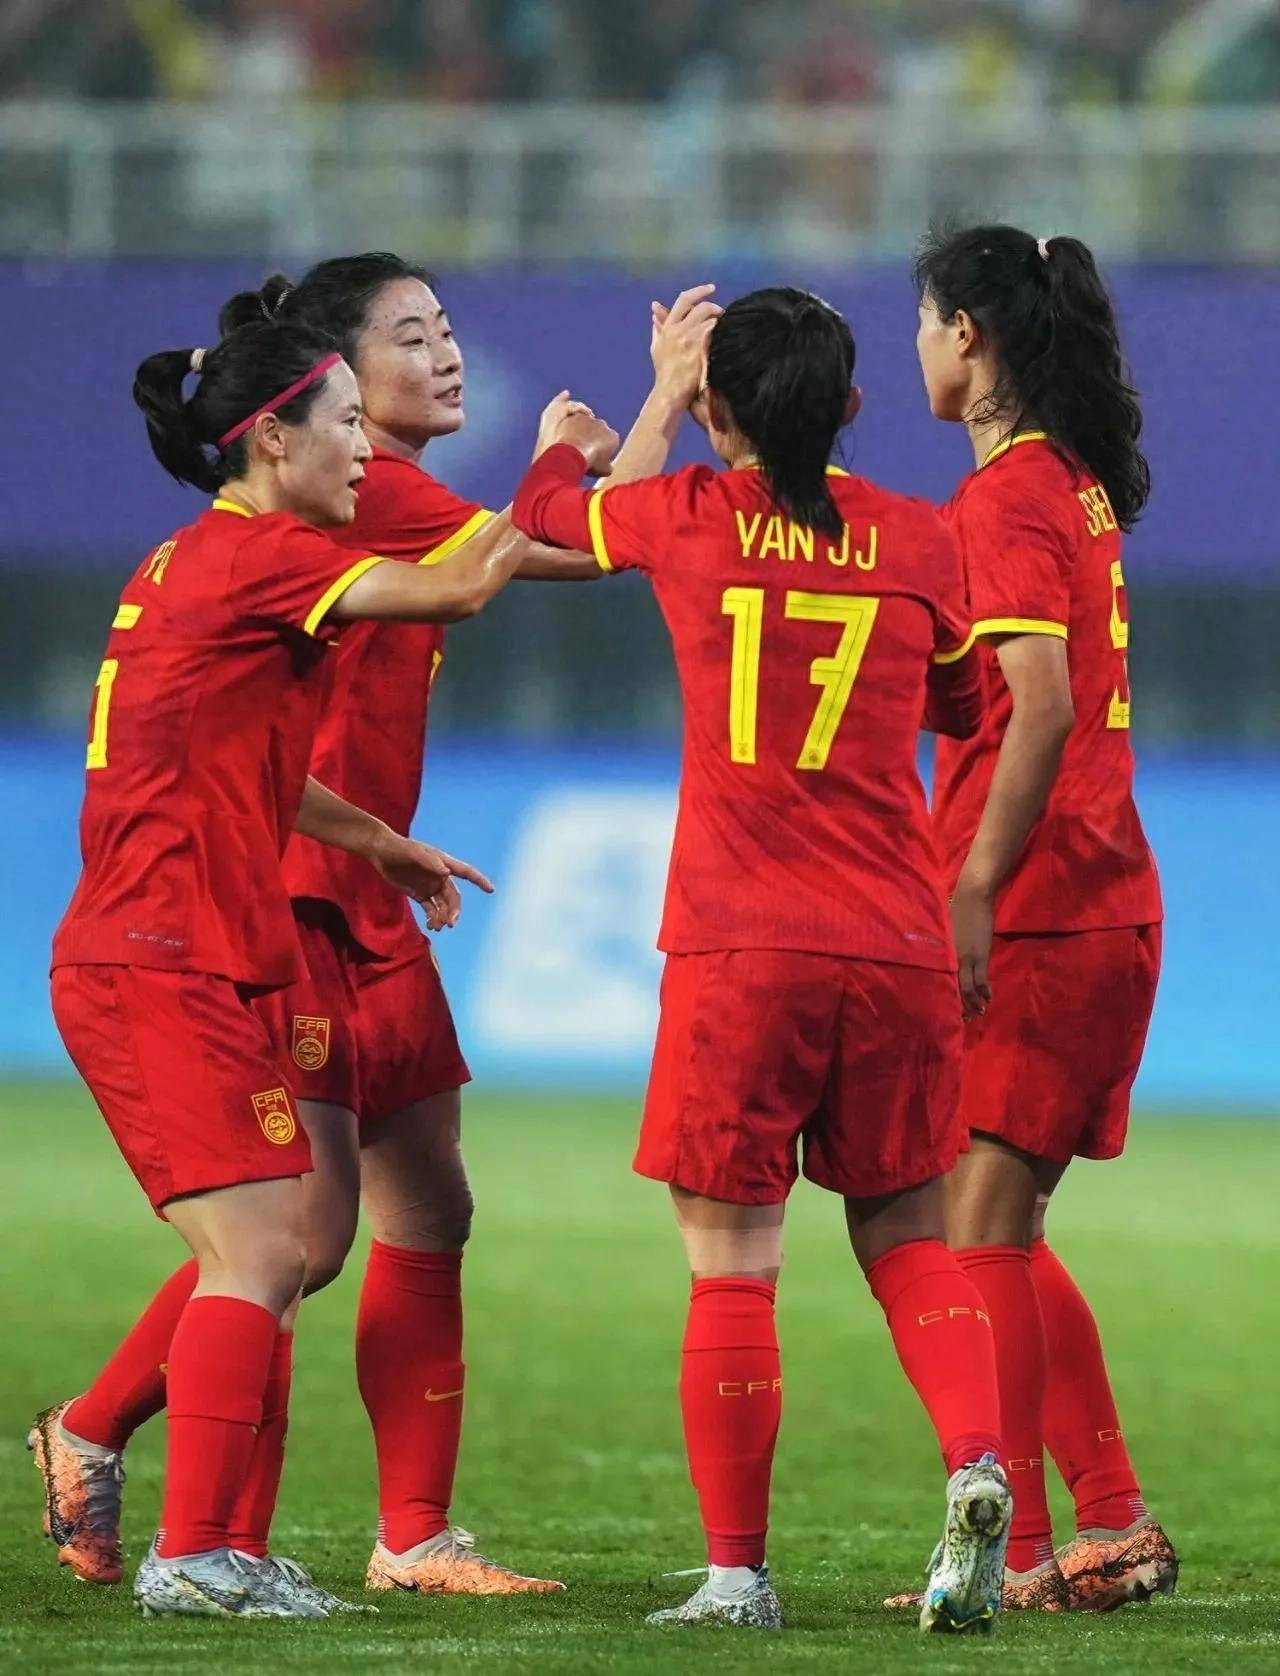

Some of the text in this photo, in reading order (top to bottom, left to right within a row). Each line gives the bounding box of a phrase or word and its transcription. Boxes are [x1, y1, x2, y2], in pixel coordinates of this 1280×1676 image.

[735, 510, 877, 570] YAN JJ
[721, 586, 880, 770] 17
[296, 1020, 327, 1031] CFA
[255, 1092, 284, 1107] CFA
[918, 1307, 991, 1328] CFA
